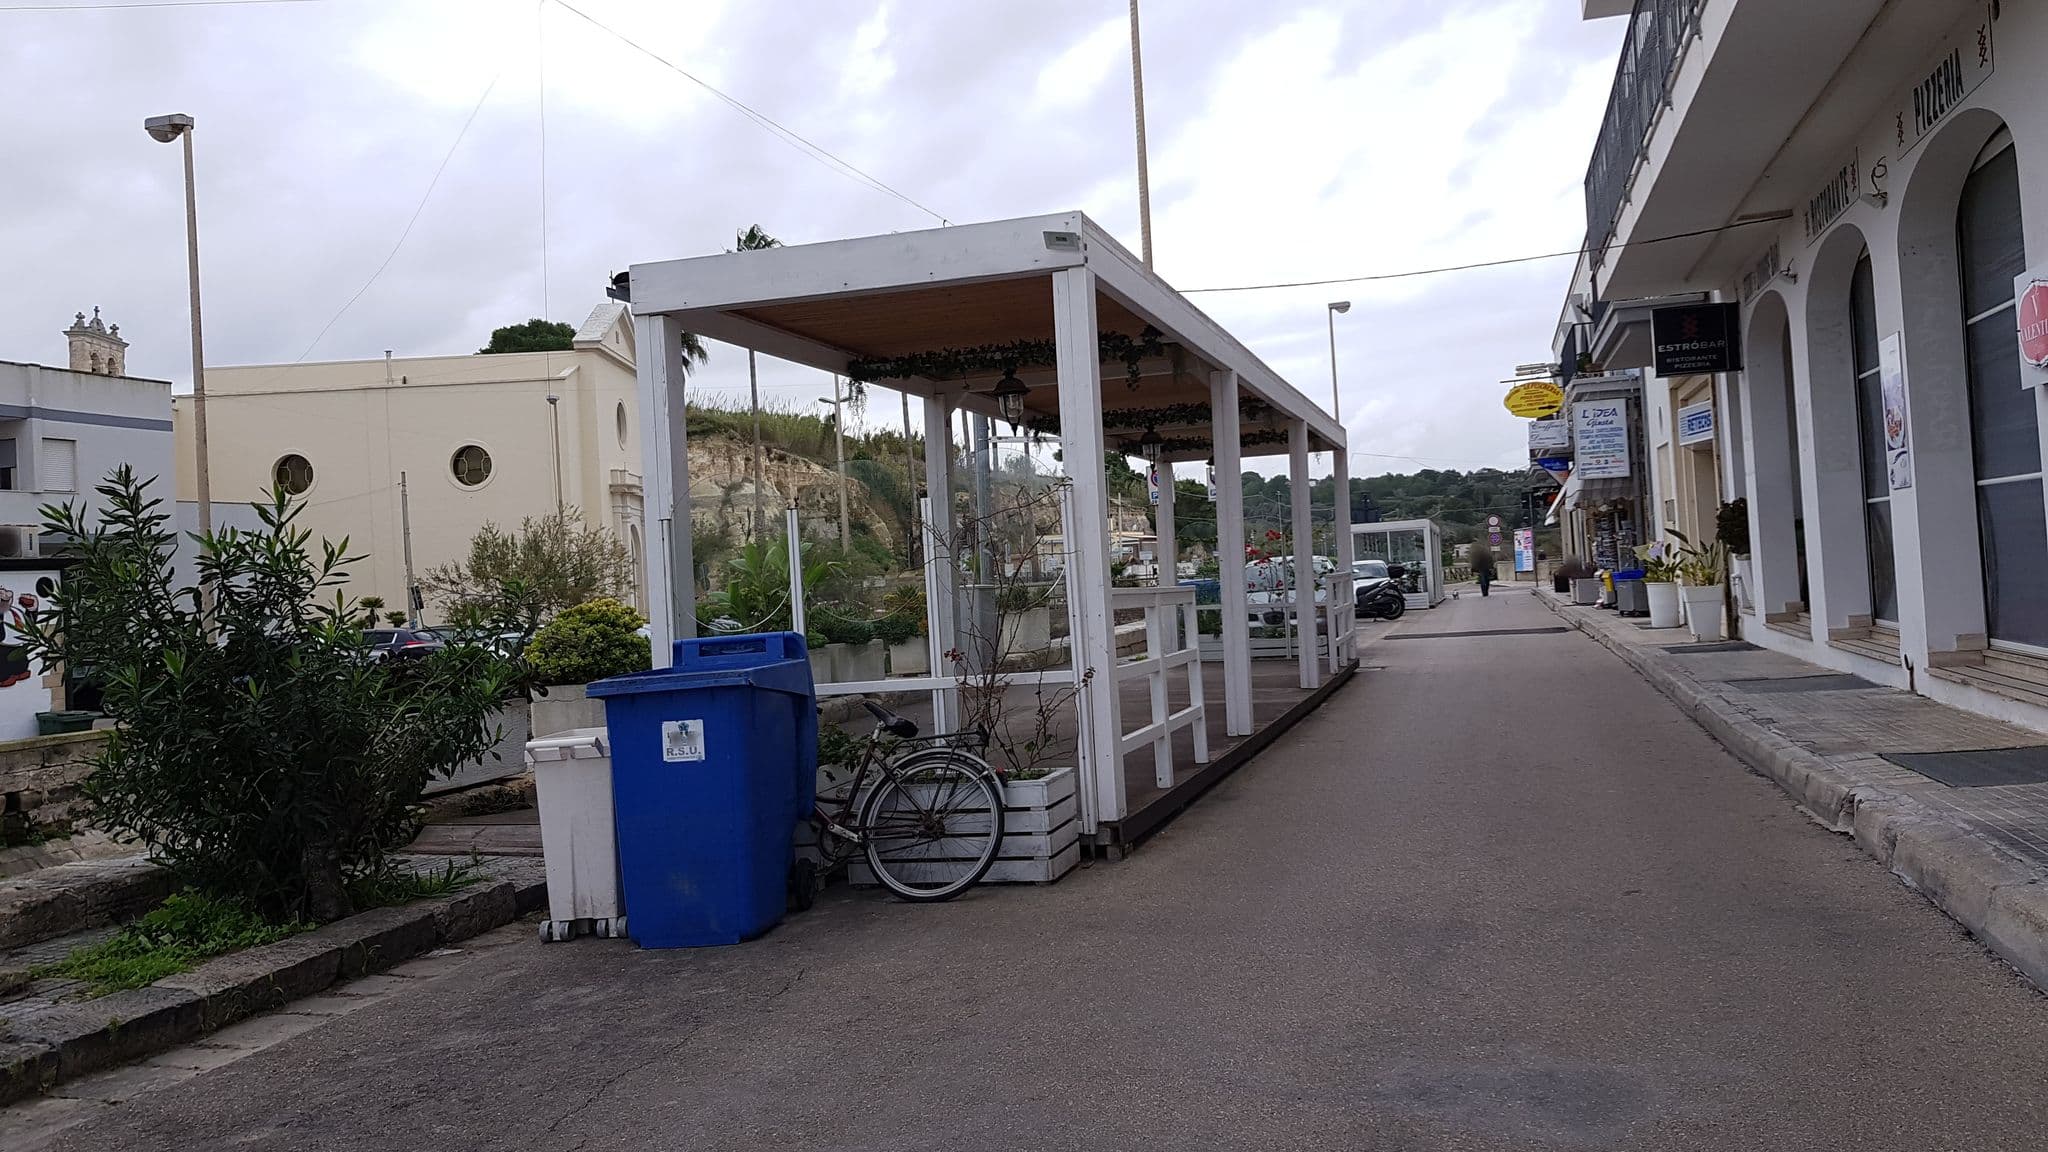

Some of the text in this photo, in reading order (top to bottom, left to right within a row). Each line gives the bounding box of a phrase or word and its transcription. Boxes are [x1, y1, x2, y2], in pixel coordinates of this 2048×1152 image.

[1913, 47, 1965, 136] PIZZERIA
[1809, 166, 1849, 237] RISTORANTE
[1657, 340, 1726, 353] ESTRÓBAR
[1666, 354, 1718, 364] RISTORANTE
[1674, 361, 1712, 369] PIZZERIA
[666, 746, 702, 756] R.S.U.
